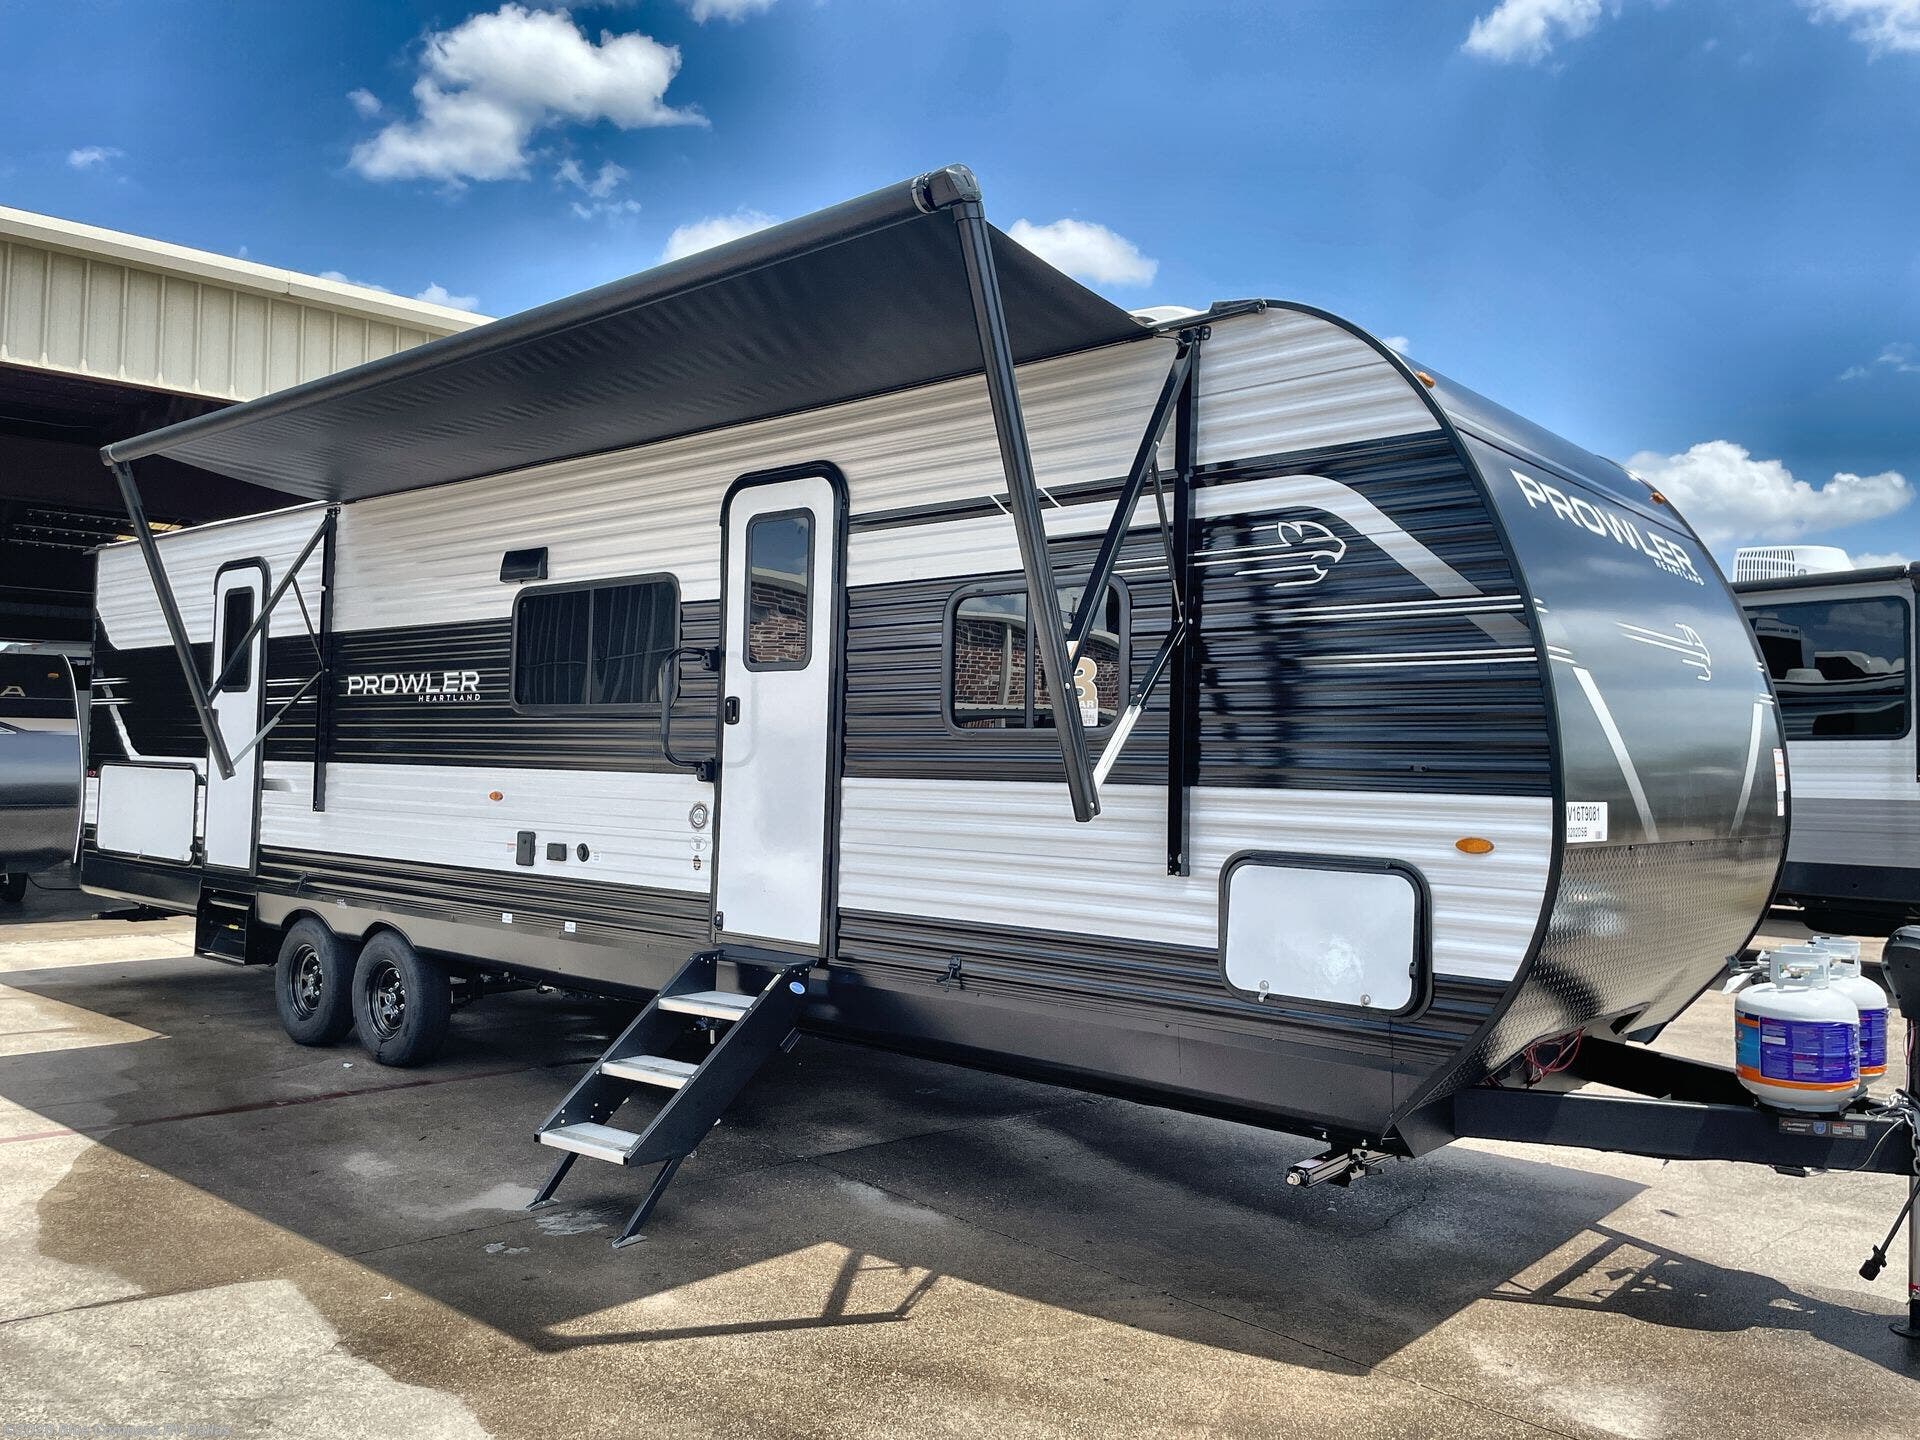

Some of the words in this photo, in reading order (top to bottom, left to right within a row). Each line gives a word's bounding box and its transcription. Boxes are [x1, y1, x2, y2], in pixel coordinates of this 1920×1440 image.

[1509, 468, 1699, 576] PROWLER
[1653, 558, 1705, 586] HEARTLAND
[347, 671, 480, 695] PROWLER
[418, 693, 481, 703] HEARTLAND
[1568, 805, 1600, 822] V16T9081
